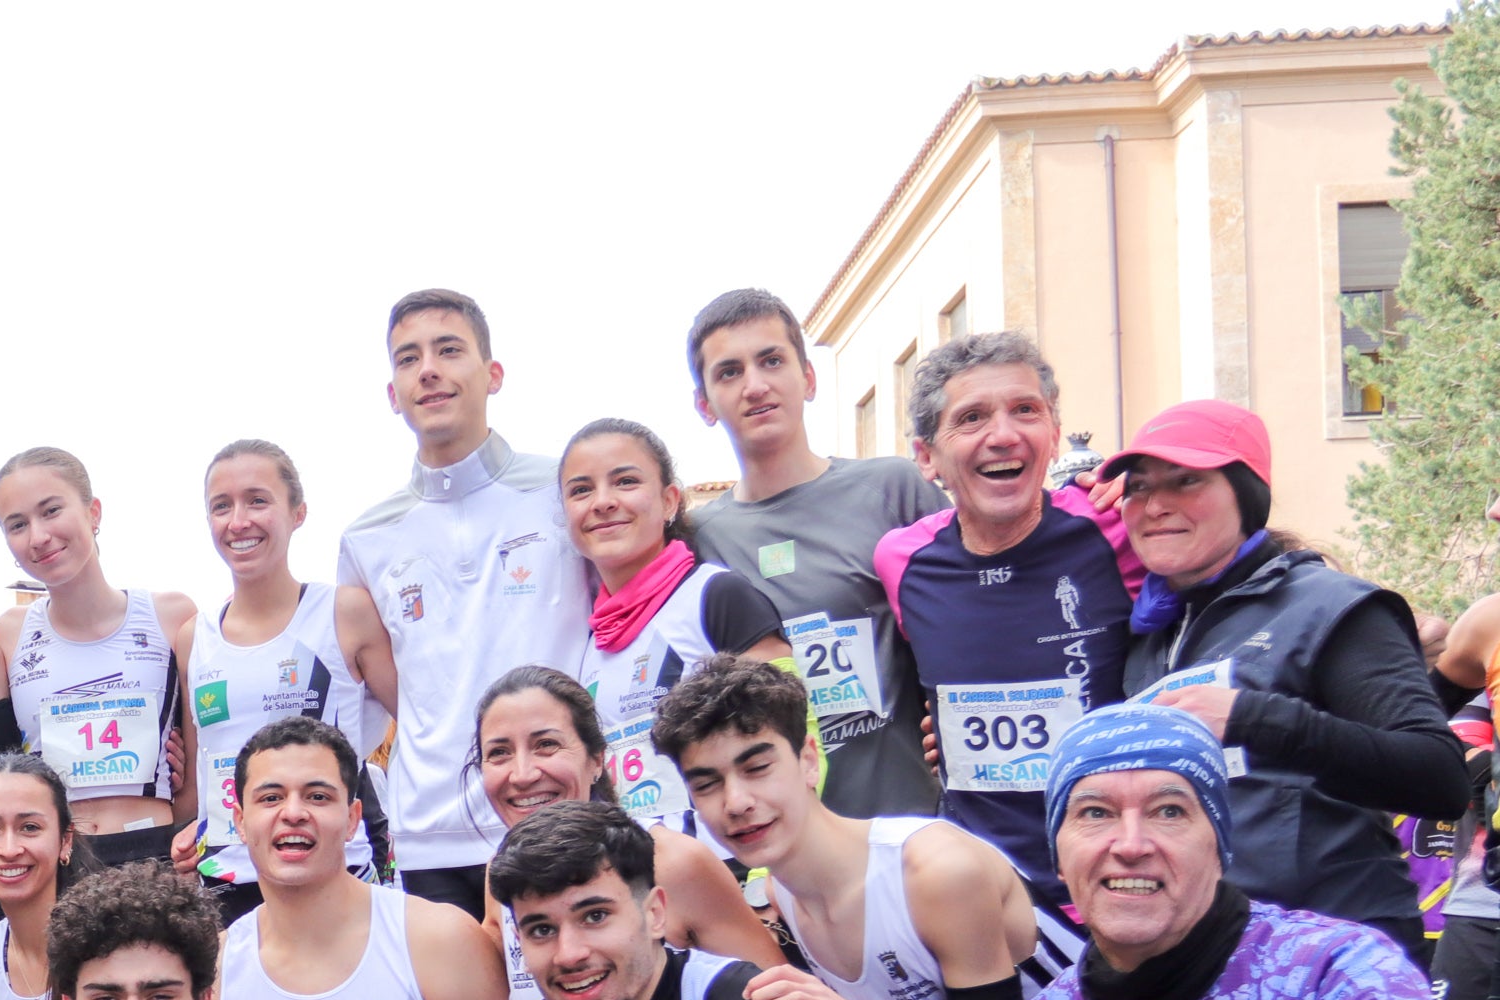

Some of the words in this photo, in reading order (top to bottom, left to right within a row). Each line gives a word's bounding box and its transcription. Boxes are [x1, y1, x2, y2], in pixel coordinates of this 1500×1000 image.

[805, 640, 852, 678] 20
[262, 690, 319, 702] Ayuntamiento
[619, 686, 669, 703] Ayuntamiento
[960, 690, 1005, 702] CARRERA
[1007, 686, 1065, 702] SOLIDARIA
[61, 701, 100, 714] CARRERA
[263, 702, 273, 712] de
[275, 701, 319, 711] Salamanca
[620, 704, 627, 713] de
[627, 698, 658, 711] Salaman
[953, 704, 988, 714] Colegio
[988, 703, 1028, 713] Maestro
[78, 719, 122, 751] 14
[963, 714, 1050, 752] 303
[68, 758, 133, 777] HESAN
[605, 749, 644, 787] 16
[972, 762, 1048, 781] HESAN
[619, 788, 656, 811] SAN
